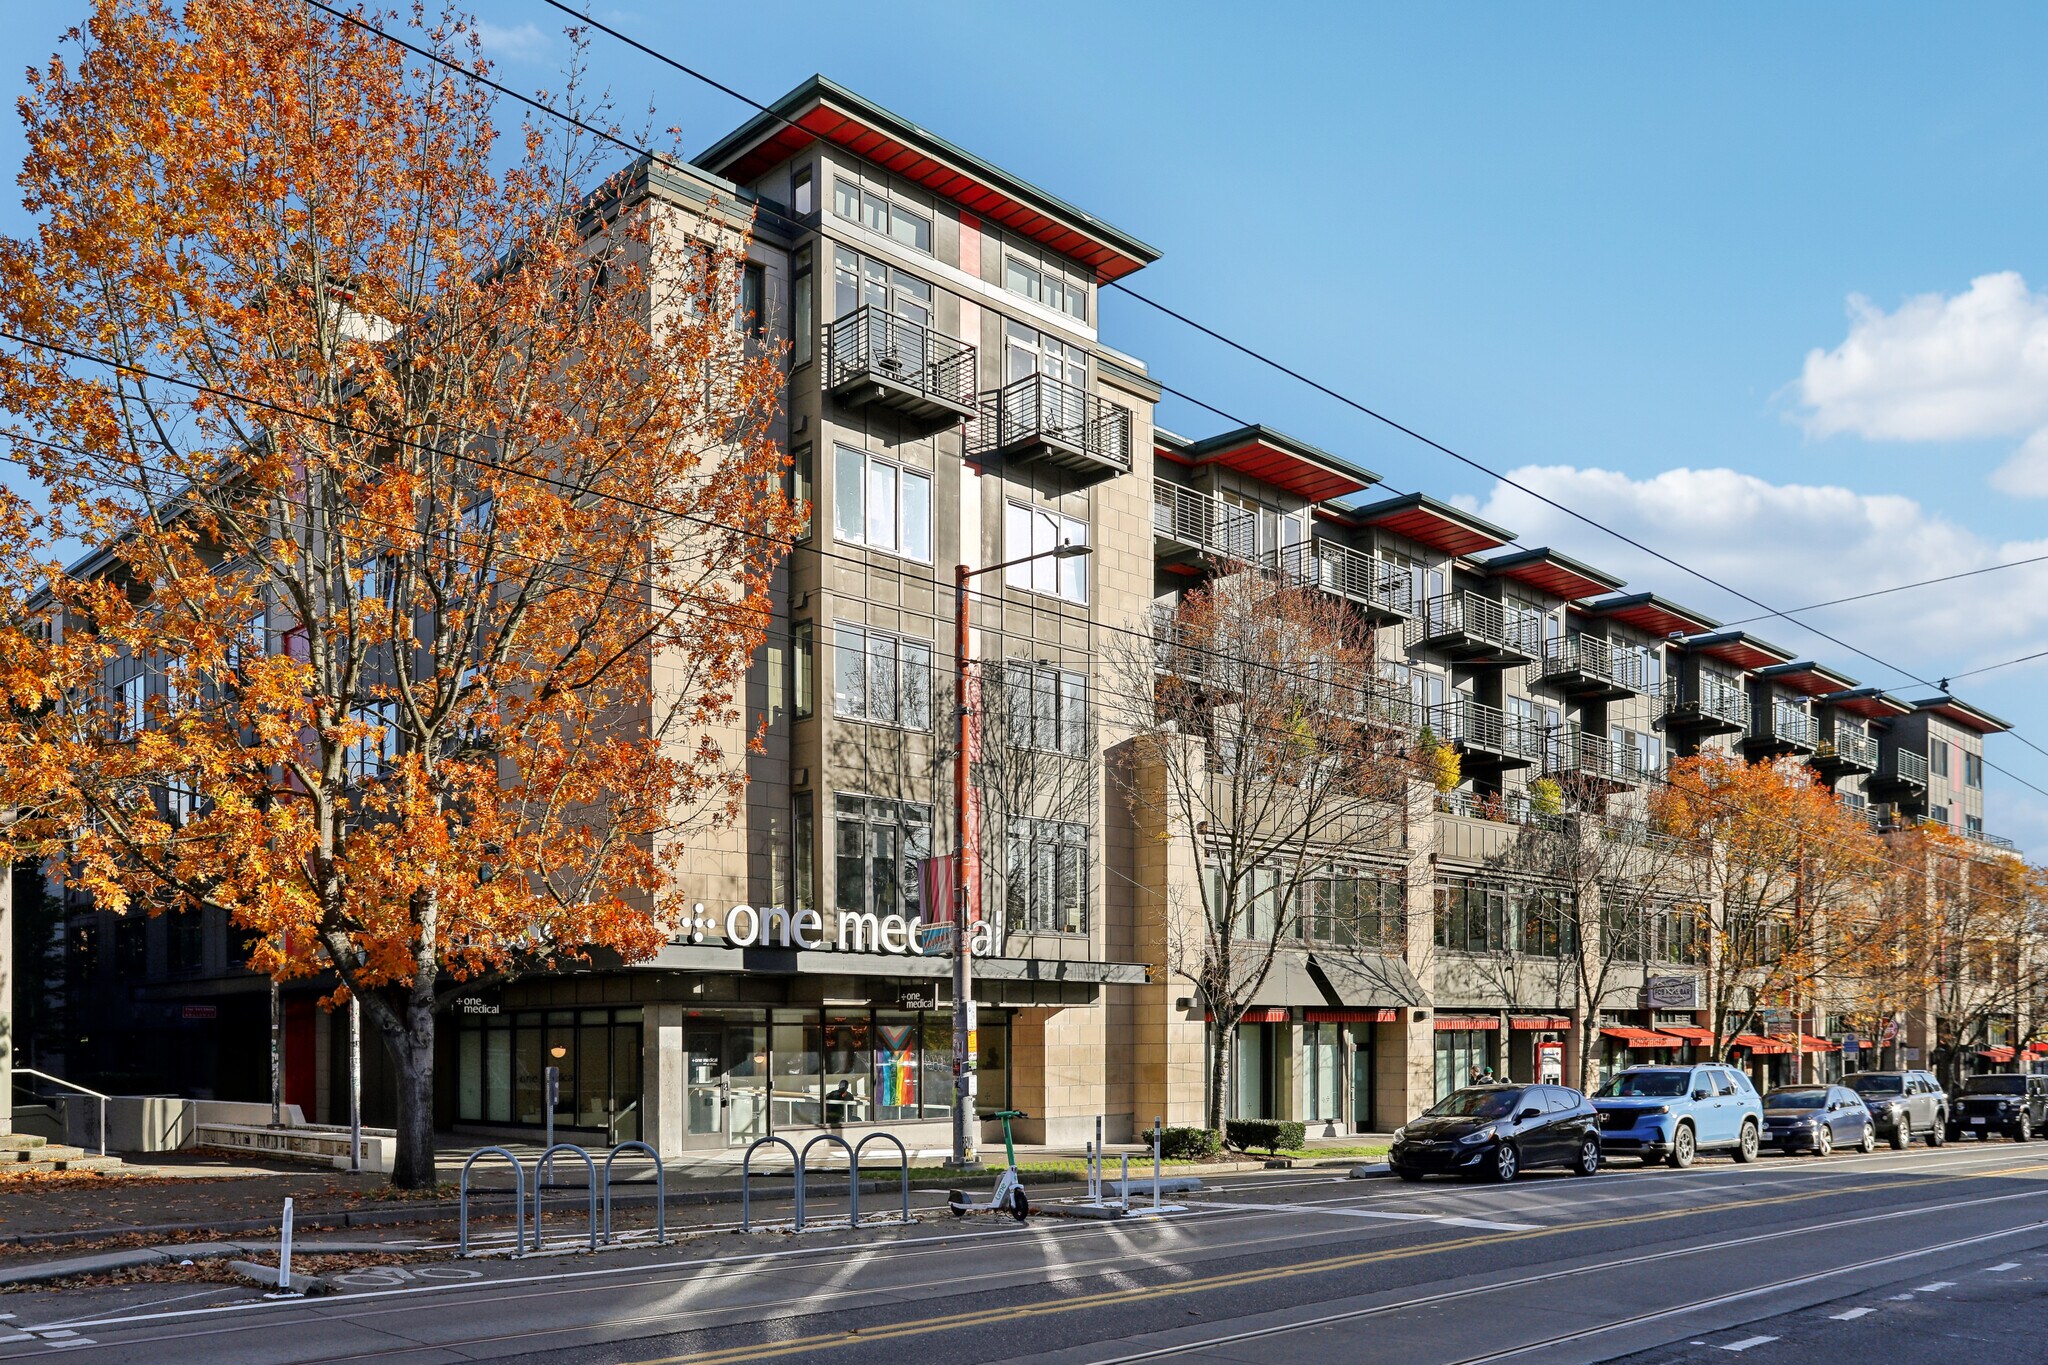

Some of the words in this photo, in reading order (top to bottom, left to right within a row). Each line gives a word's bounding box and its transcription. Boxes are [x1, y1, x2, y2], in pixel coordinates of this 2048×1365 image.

[725, 904, 822, 949] one
[837, 910, 1003, 957] meal
[906, 992, 921, 1000] one
[906, 998, 934, 1008] medical
[464, 1004, 499, 1013] medical
